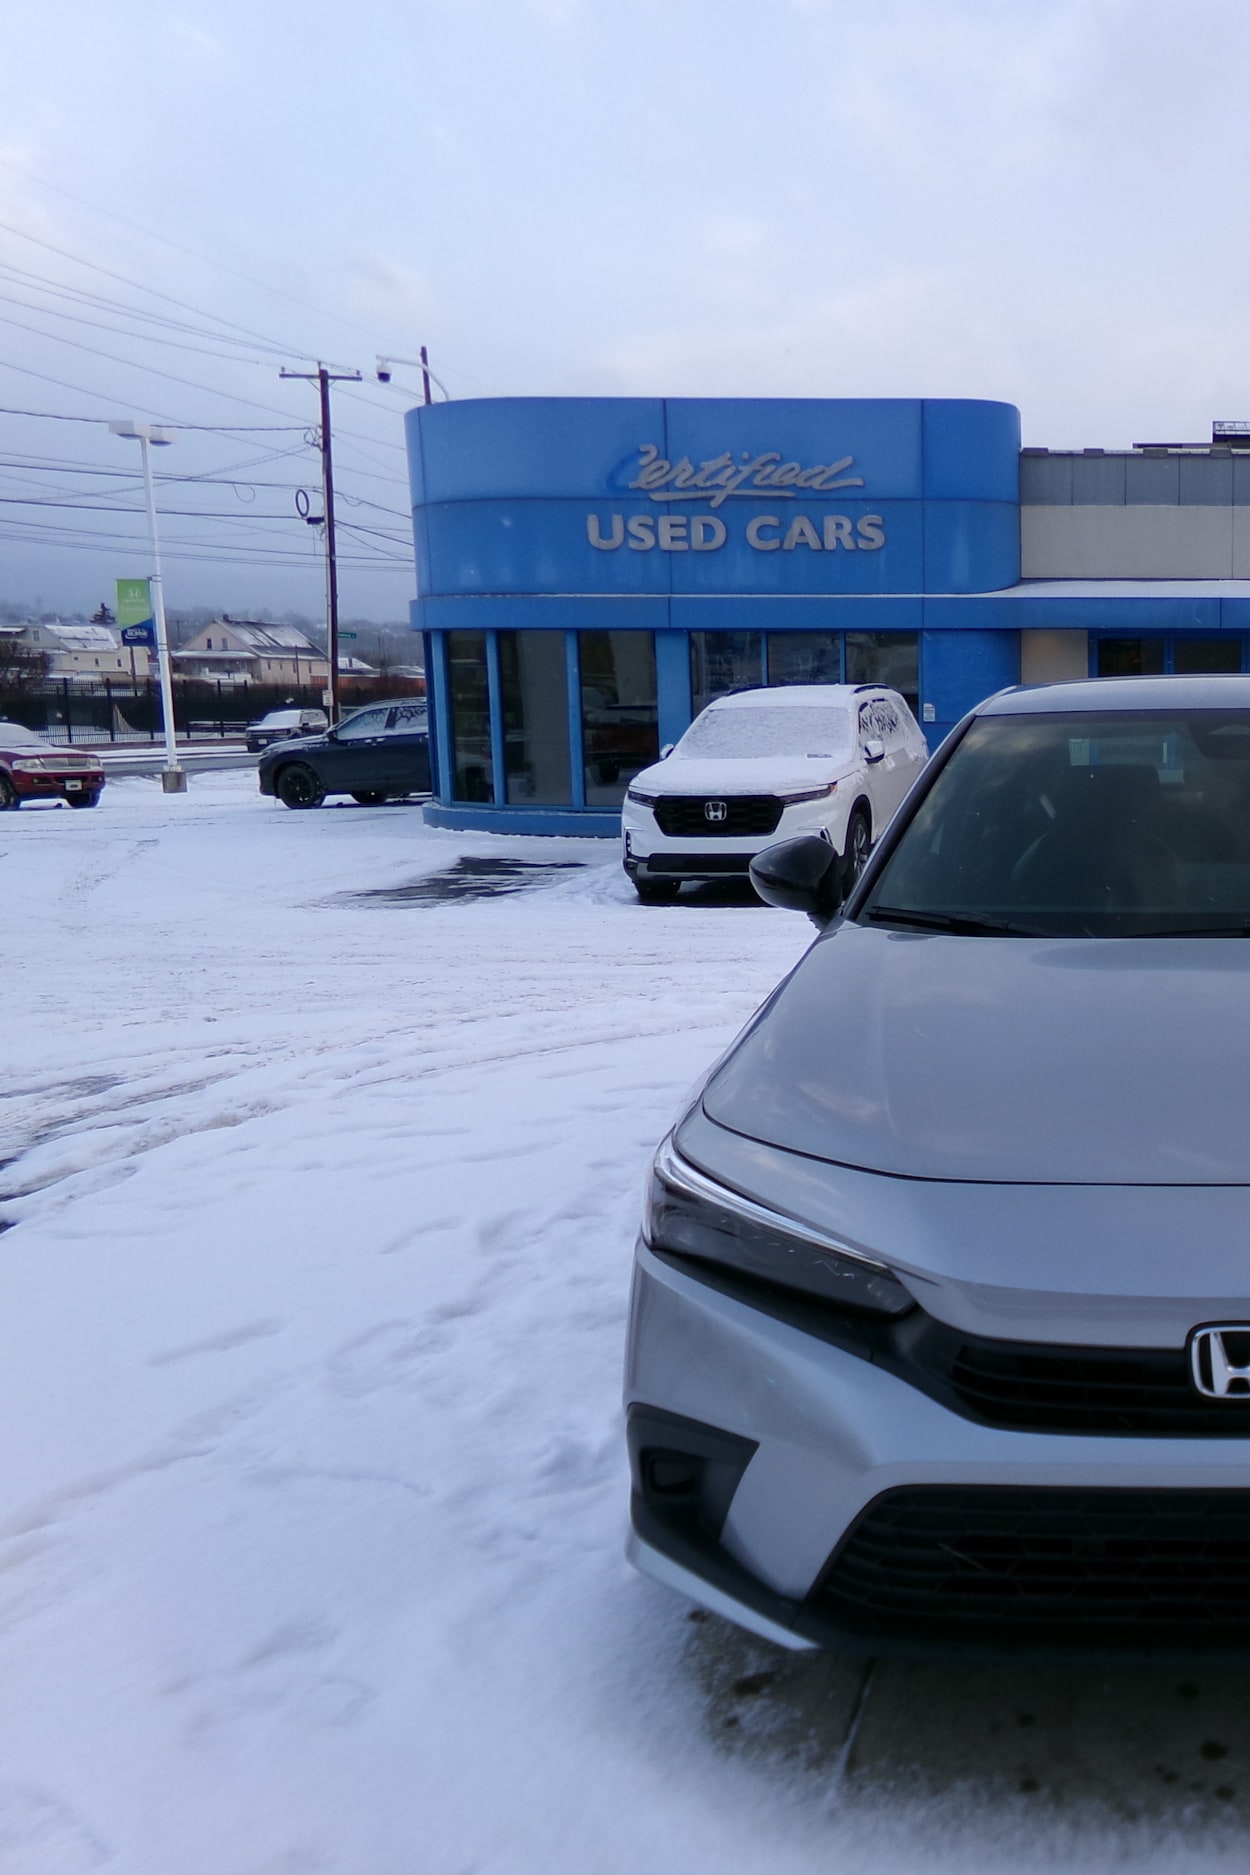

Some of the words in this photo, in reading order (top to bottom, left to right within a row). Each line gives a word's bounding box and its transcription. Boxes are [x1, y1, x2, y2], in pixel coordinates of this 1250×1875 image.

[606, 444, 864, 508] Certified
[586, 514, 727, 551] USED
[745, 514, 886, 551] CARS
